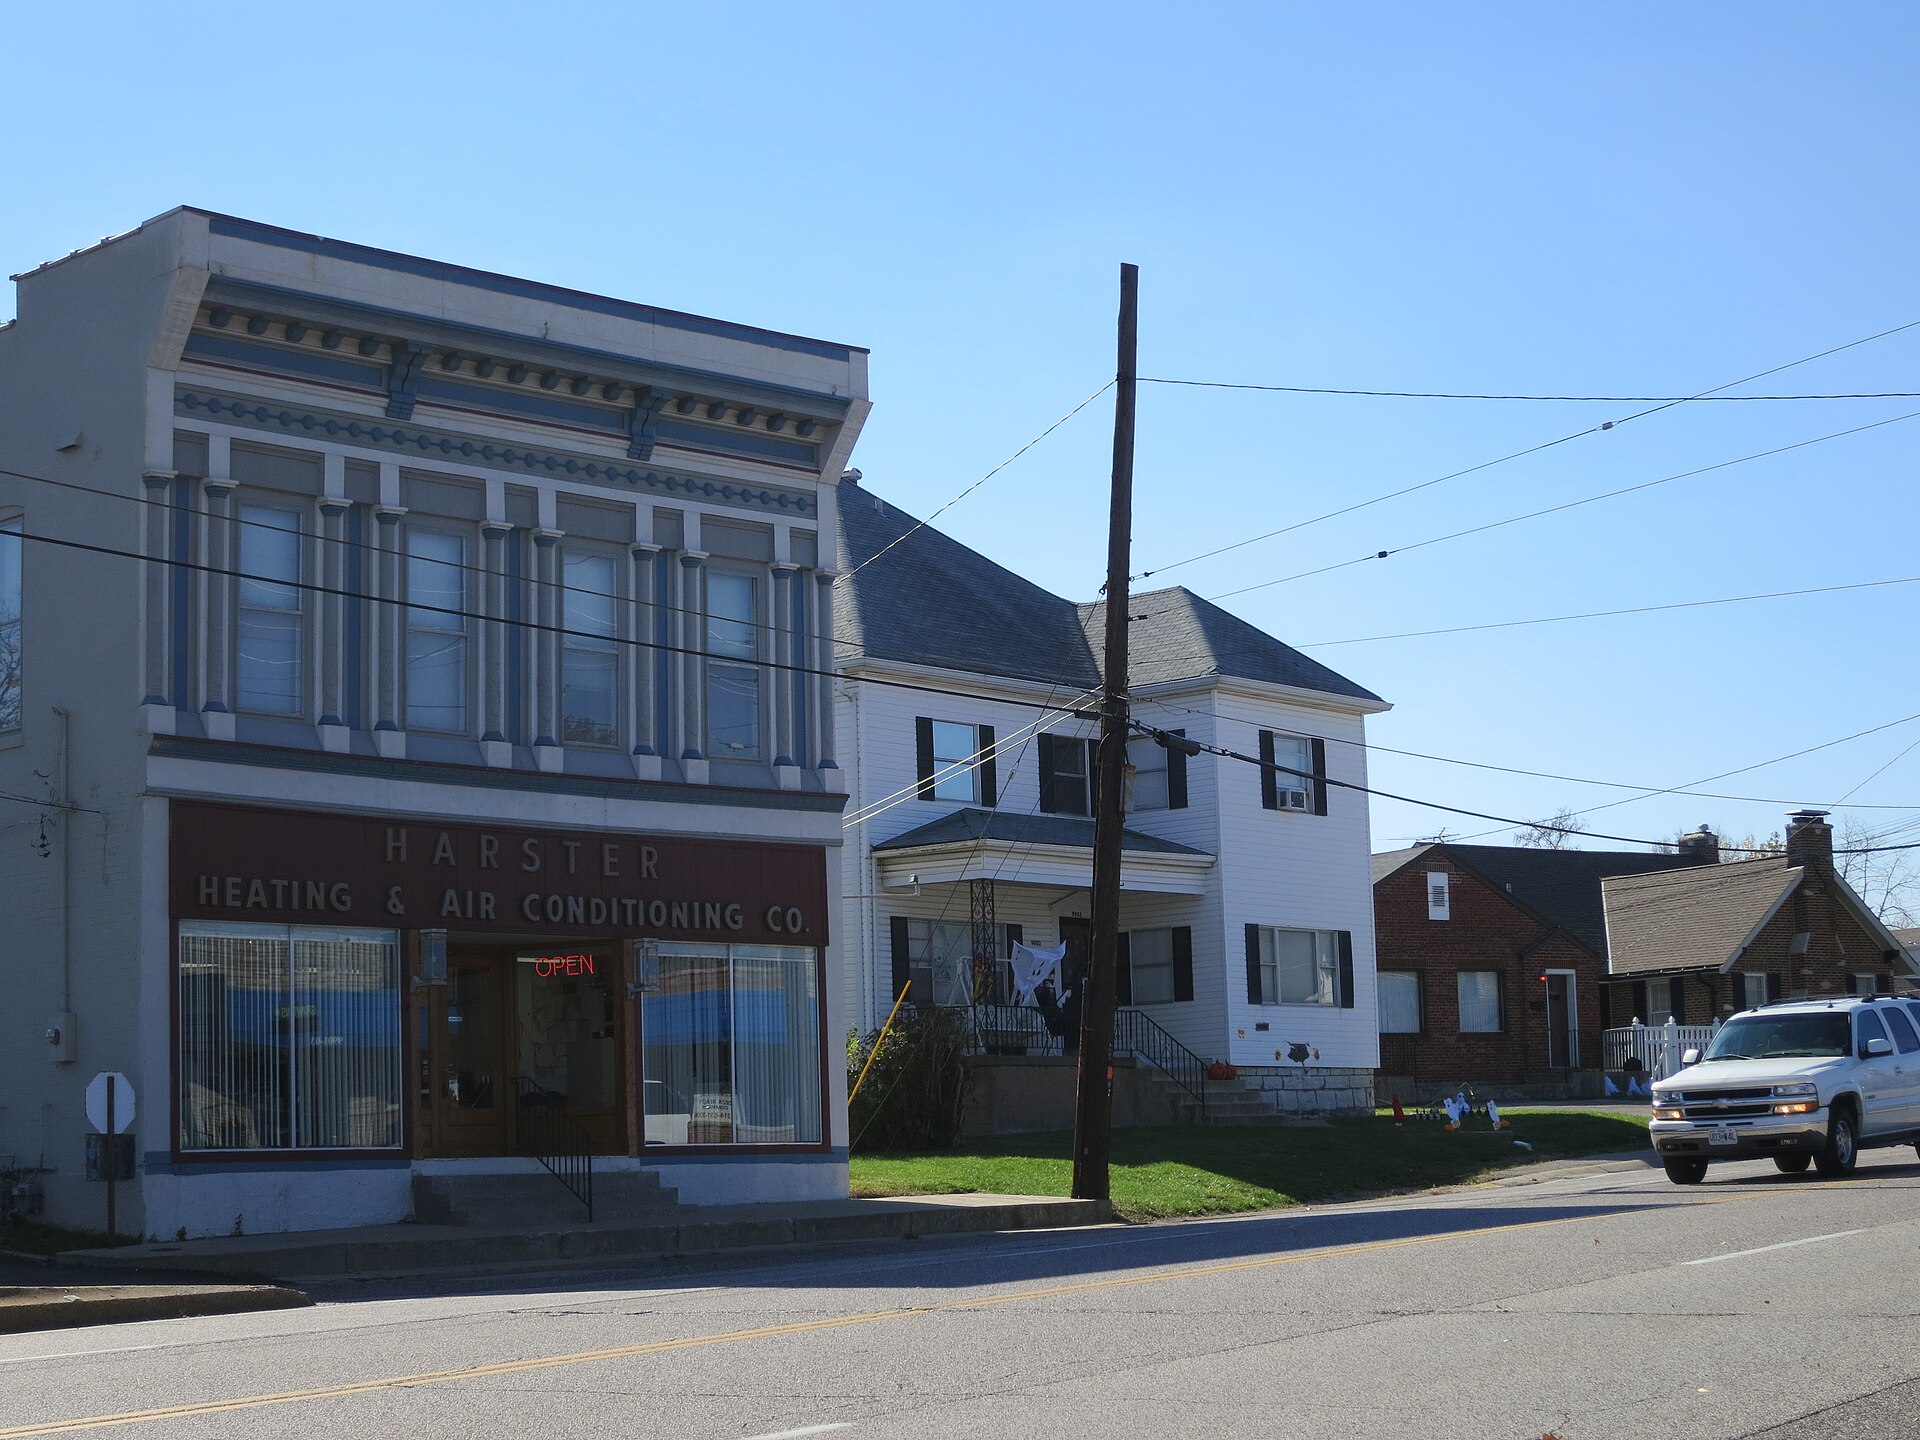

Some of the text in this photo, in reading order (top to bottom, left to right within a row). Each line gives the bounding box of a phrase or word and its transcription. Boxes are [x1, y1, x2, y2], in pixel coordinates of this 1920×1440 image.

[386, 827, 660, 880] HARSTER
[199, 874, 811, 934] HEATING & AIR CONDITIONING CO.
[534, 953, 595, 977] OPEN
